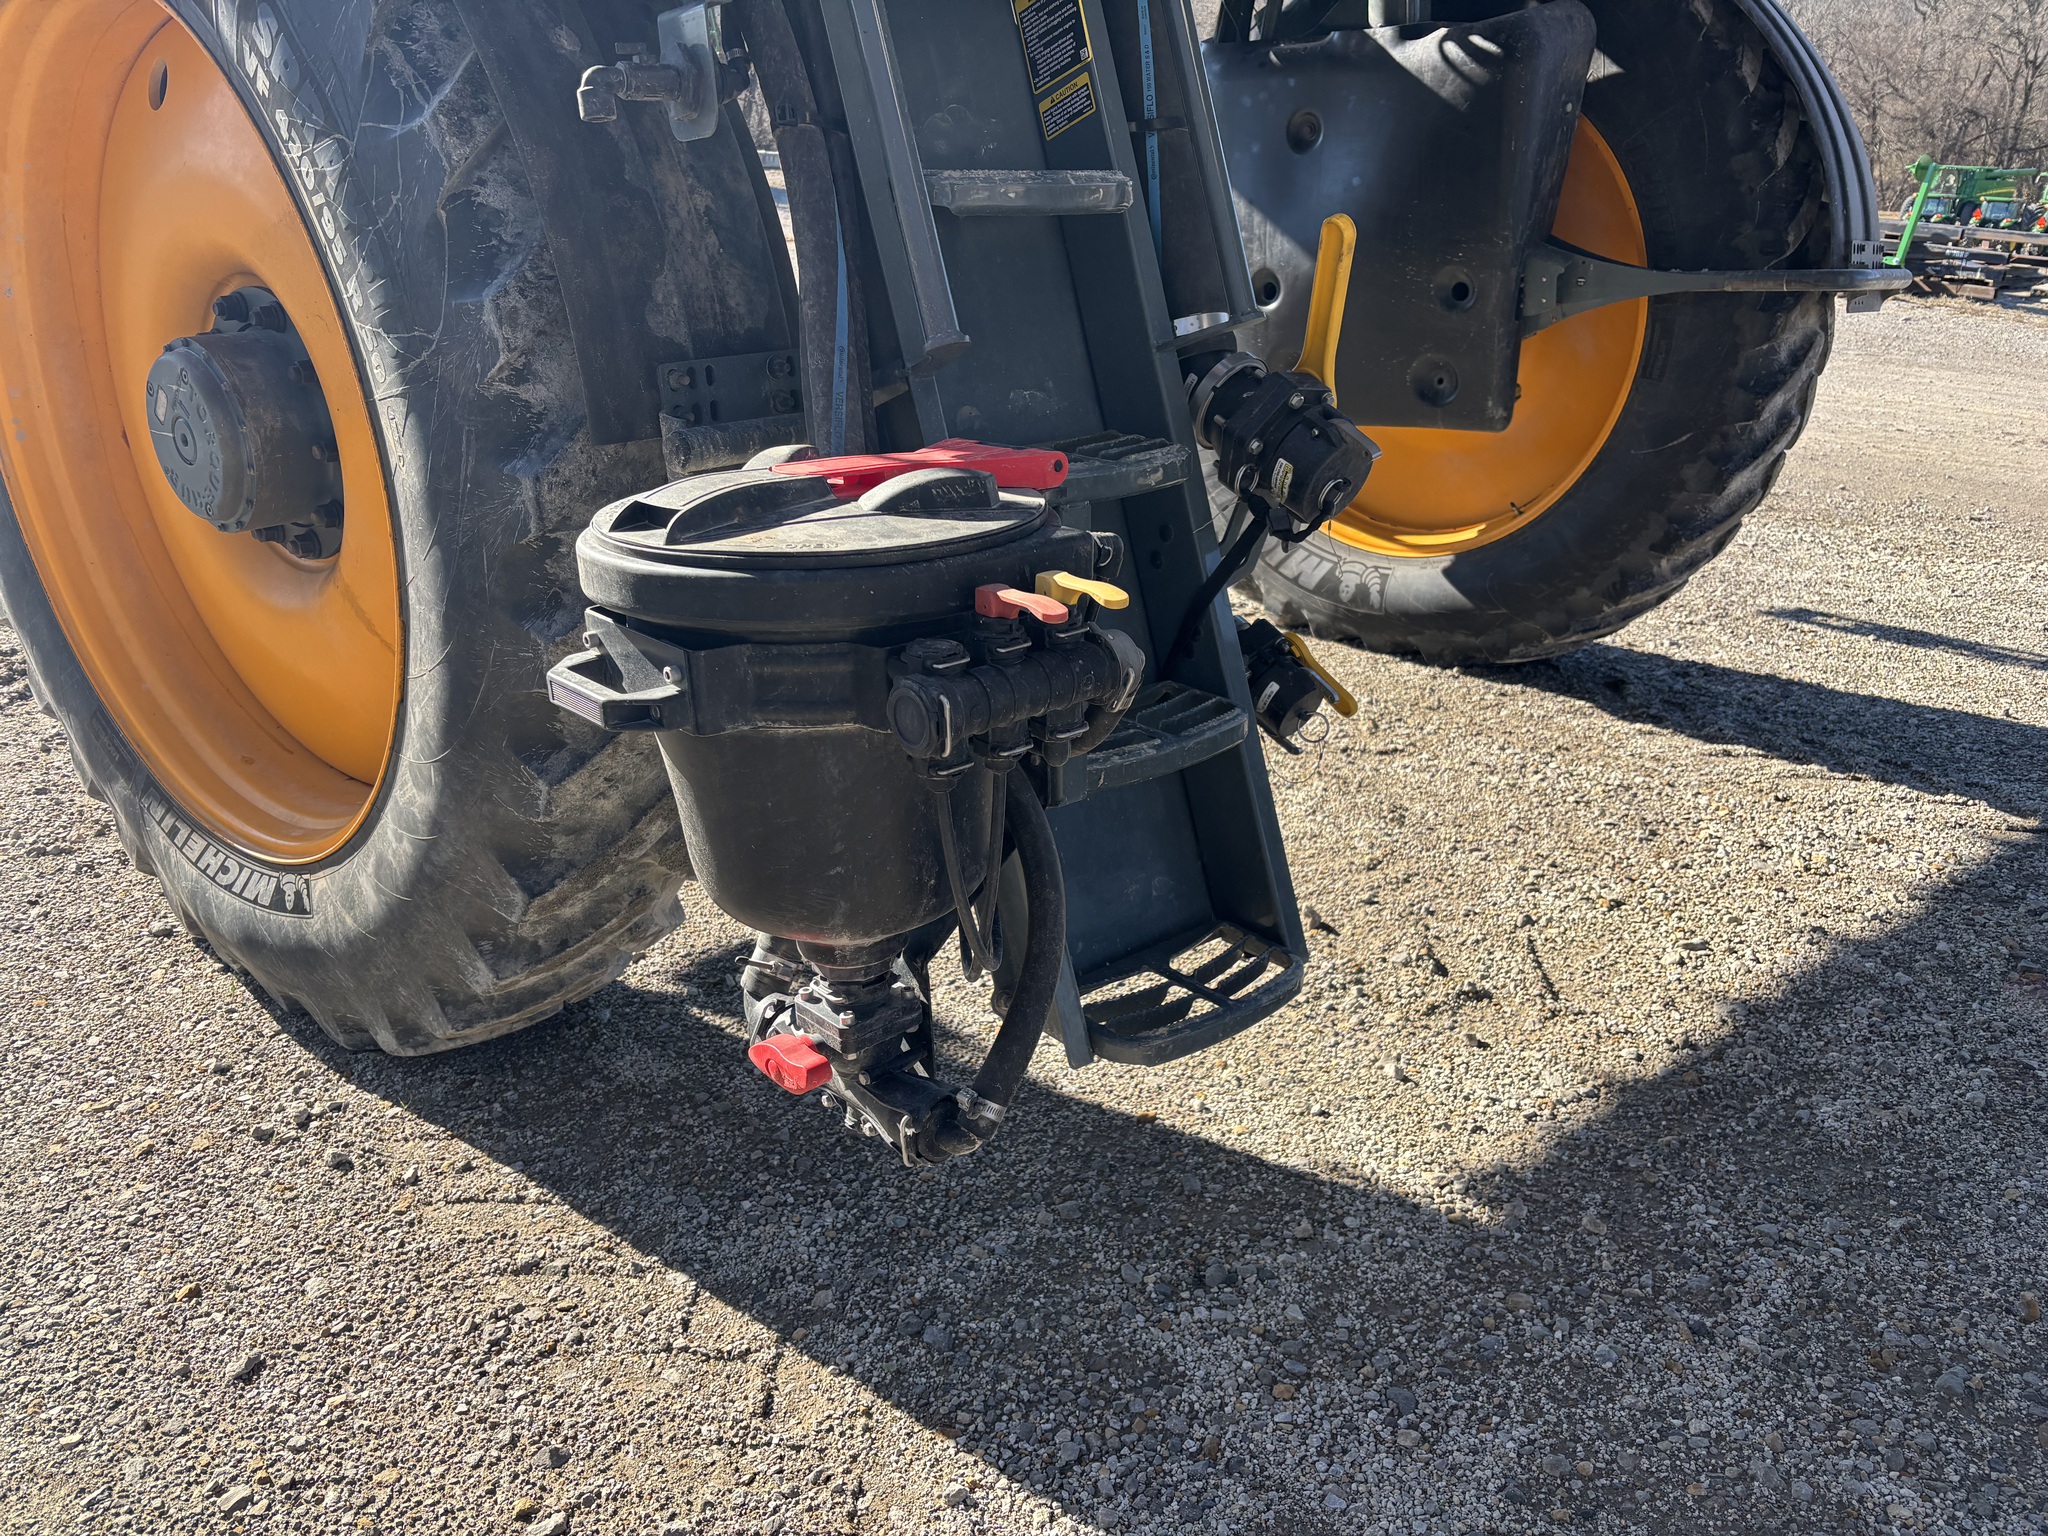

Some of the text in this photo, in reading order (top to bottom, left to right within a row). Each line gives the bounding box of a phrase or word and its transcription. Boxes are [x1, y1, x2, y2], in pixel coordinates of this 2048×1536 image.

[242, 36, 270, 98] VF
[1055, 81, 1078, 100] CAUTION
[833, 391, 844, 439] VERSIFLO
[140, 787, 278, 906] MICHELIN
